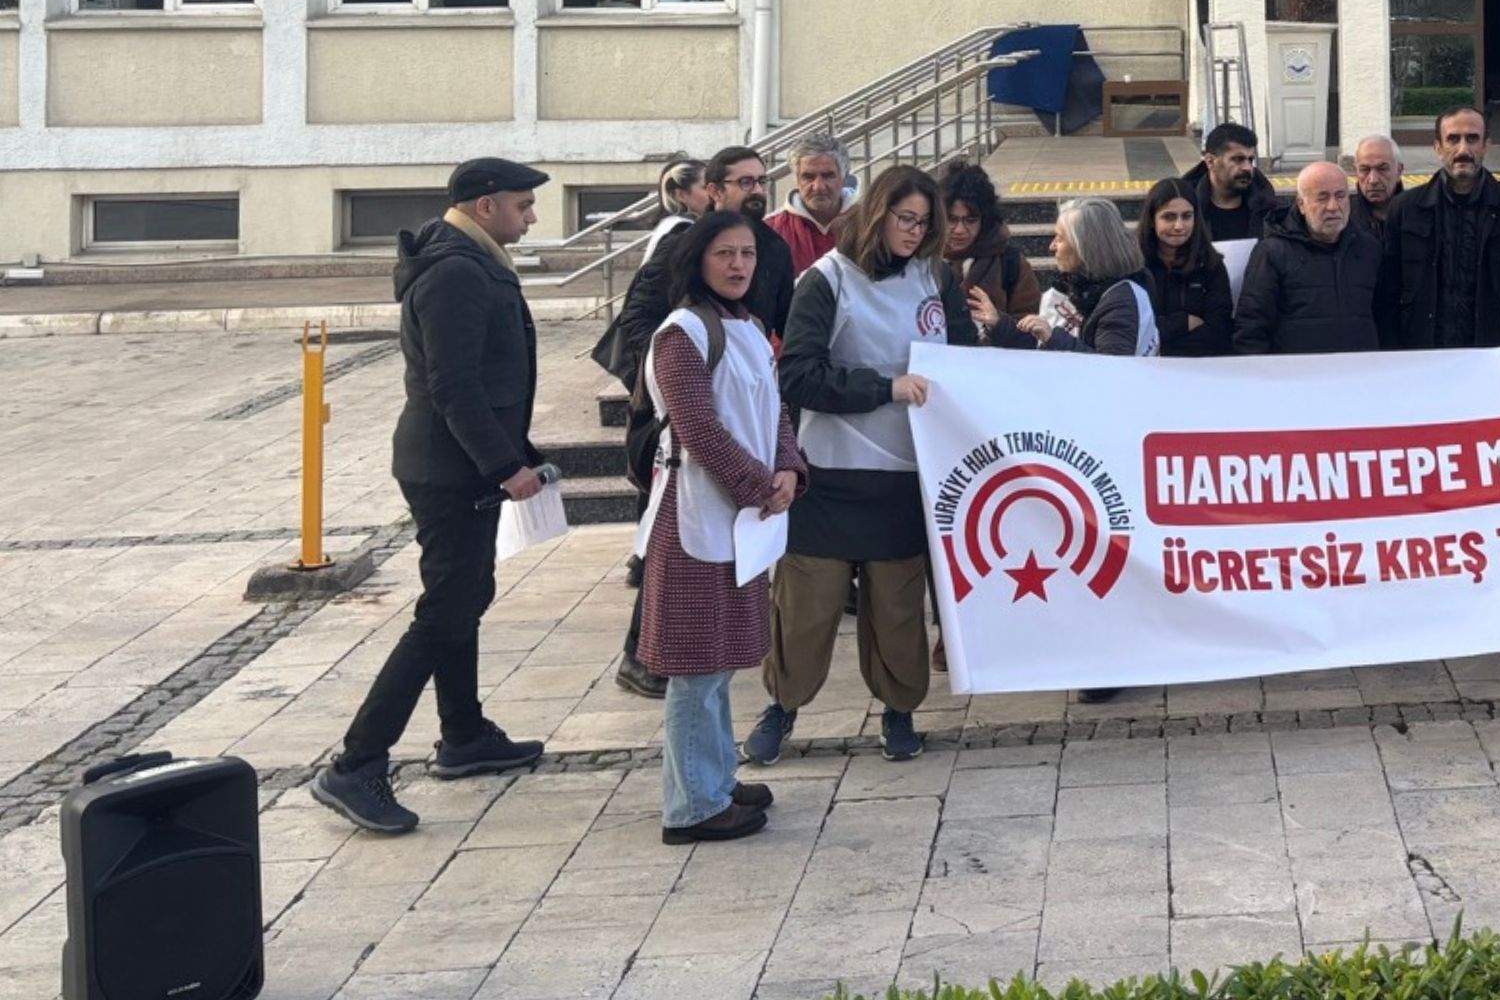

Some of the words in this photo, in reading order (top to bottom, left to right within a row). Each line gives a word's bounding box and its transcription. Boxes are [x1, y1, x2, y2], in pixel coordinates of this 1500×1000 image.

[962, 437, 1005, 475] HALK
[1003, 429, 1103, 478] TEMSİLCİLERİ
[1091, 471, 1135, 531] MECLİSİ
[1155, 444, 1466, 505] HARMANTEPE
[1162, 531, 1367, 595] ÜCRETSİZ
[1375, 531, 1488, 584] KREŞ
